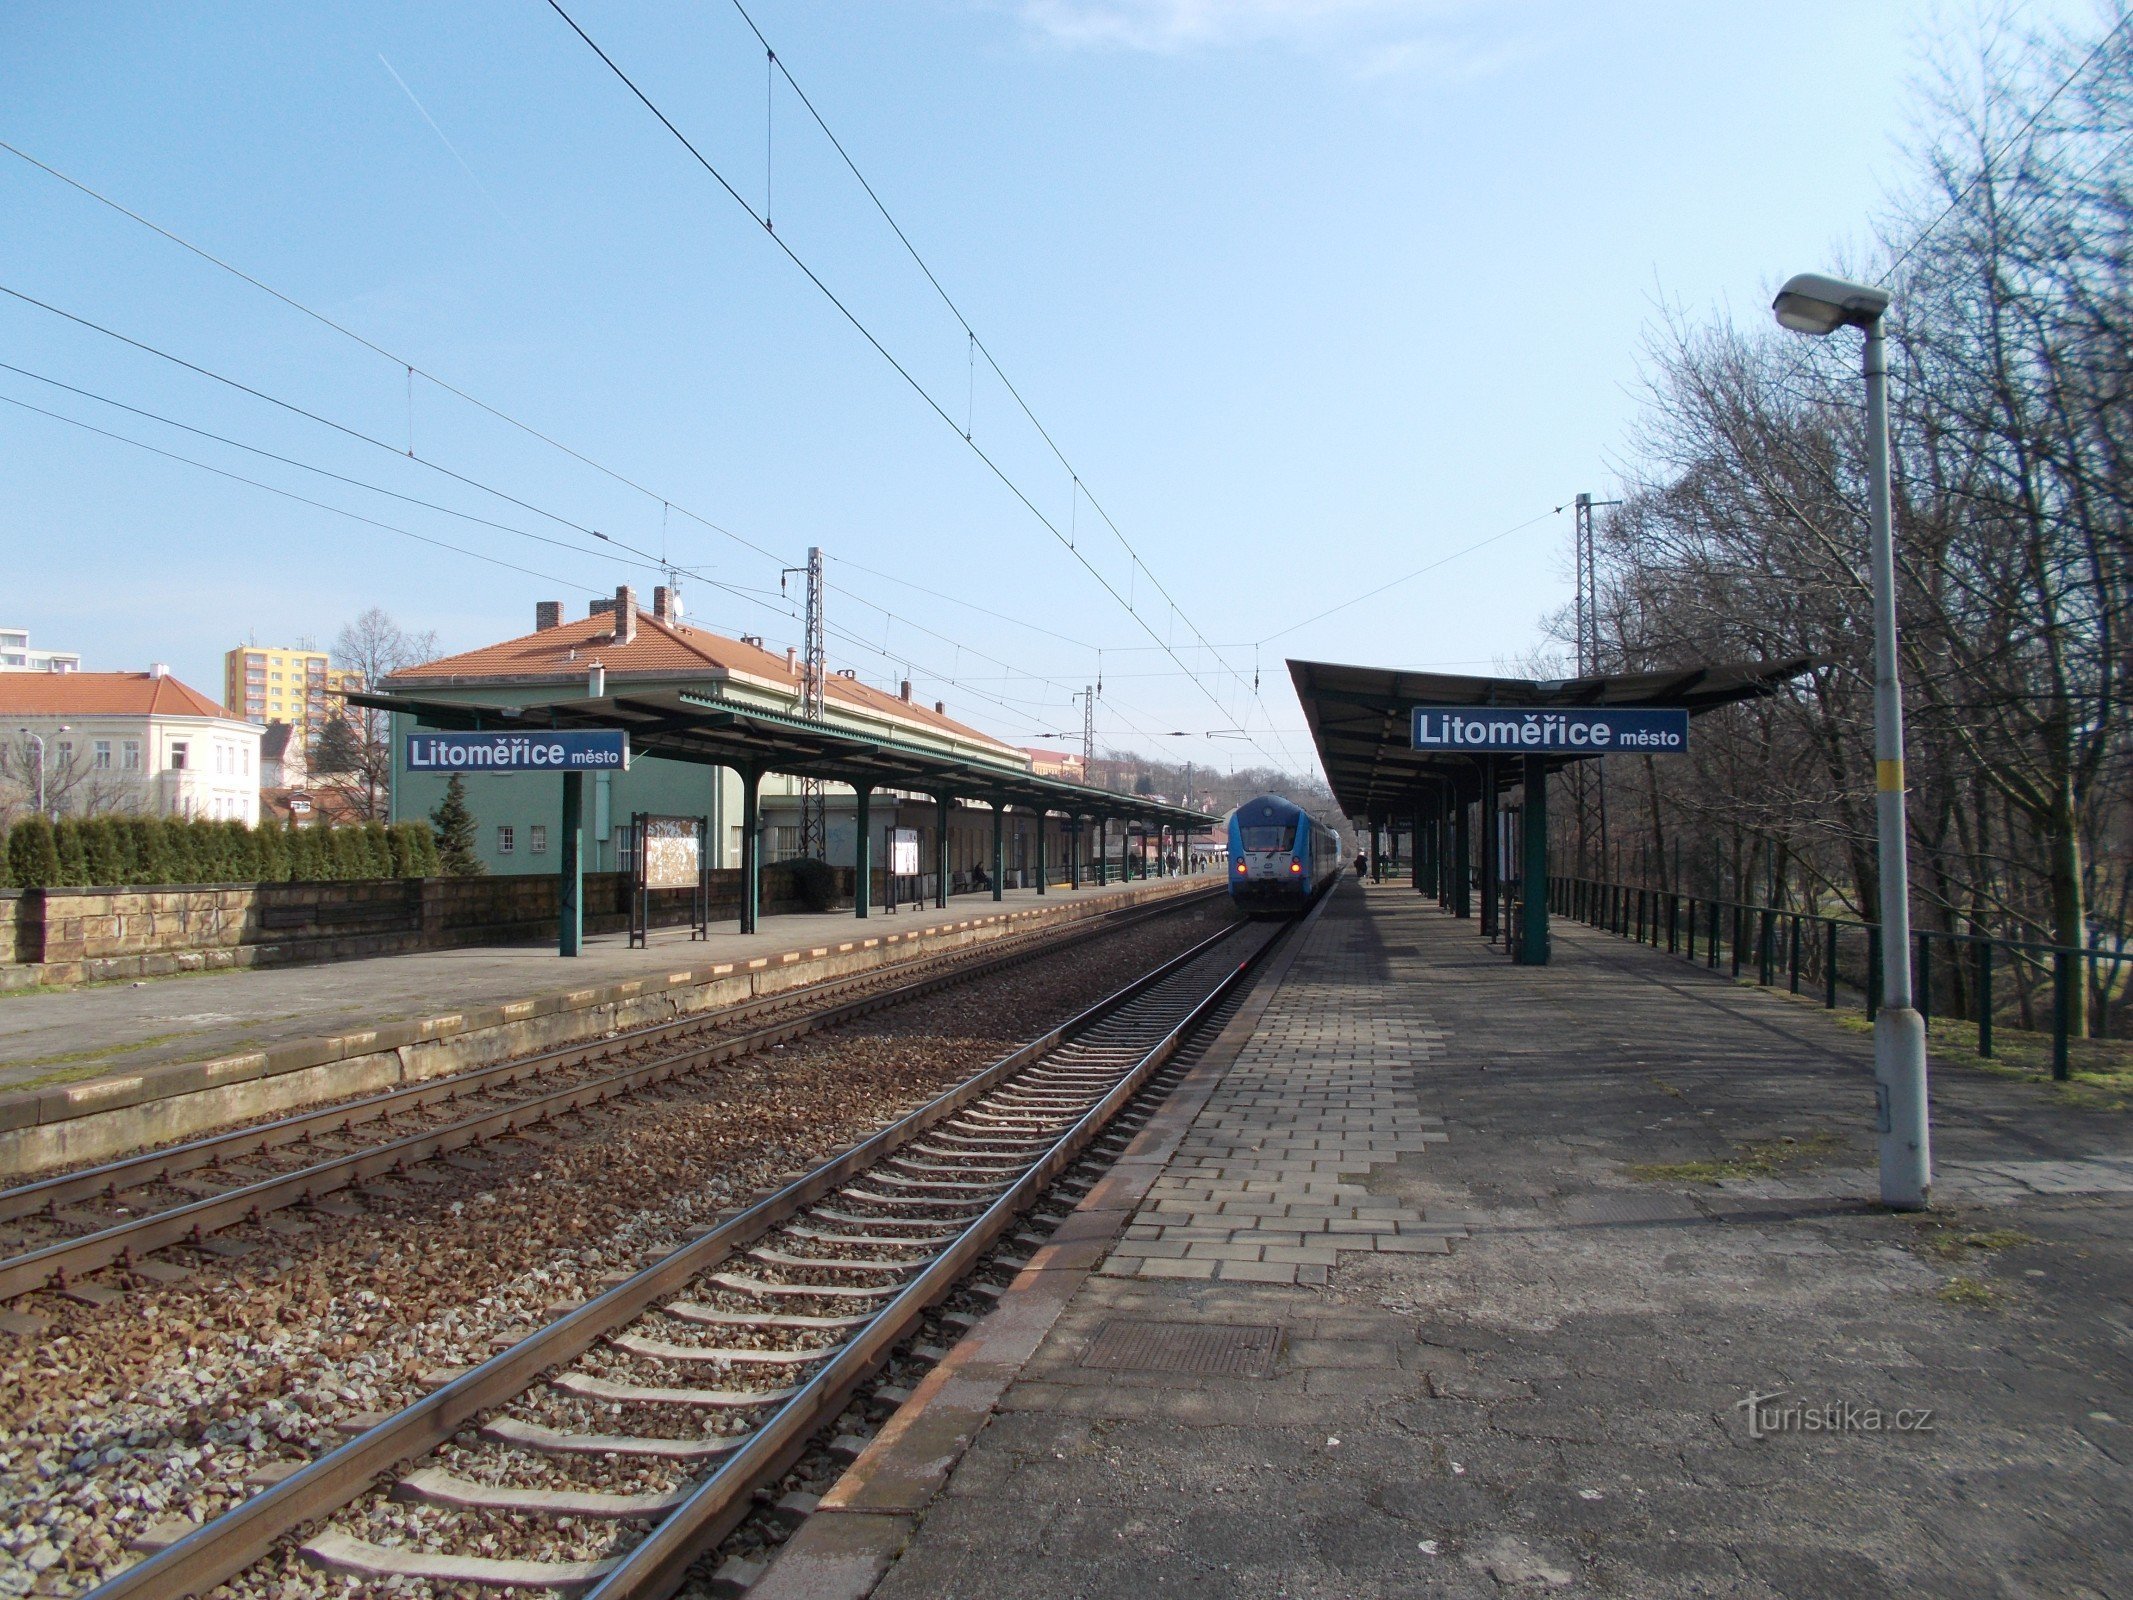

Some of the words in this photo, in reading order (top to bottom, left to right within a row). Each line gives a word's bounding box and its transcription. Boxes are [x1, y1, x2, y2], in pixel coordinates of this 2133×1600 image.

[1420, 714, 1610, 745] Litoměřice
[1620, 729, 1680, 746] město
[411, 738, 565, 766] Litoměřice
[571, 749, 619, 764] město
